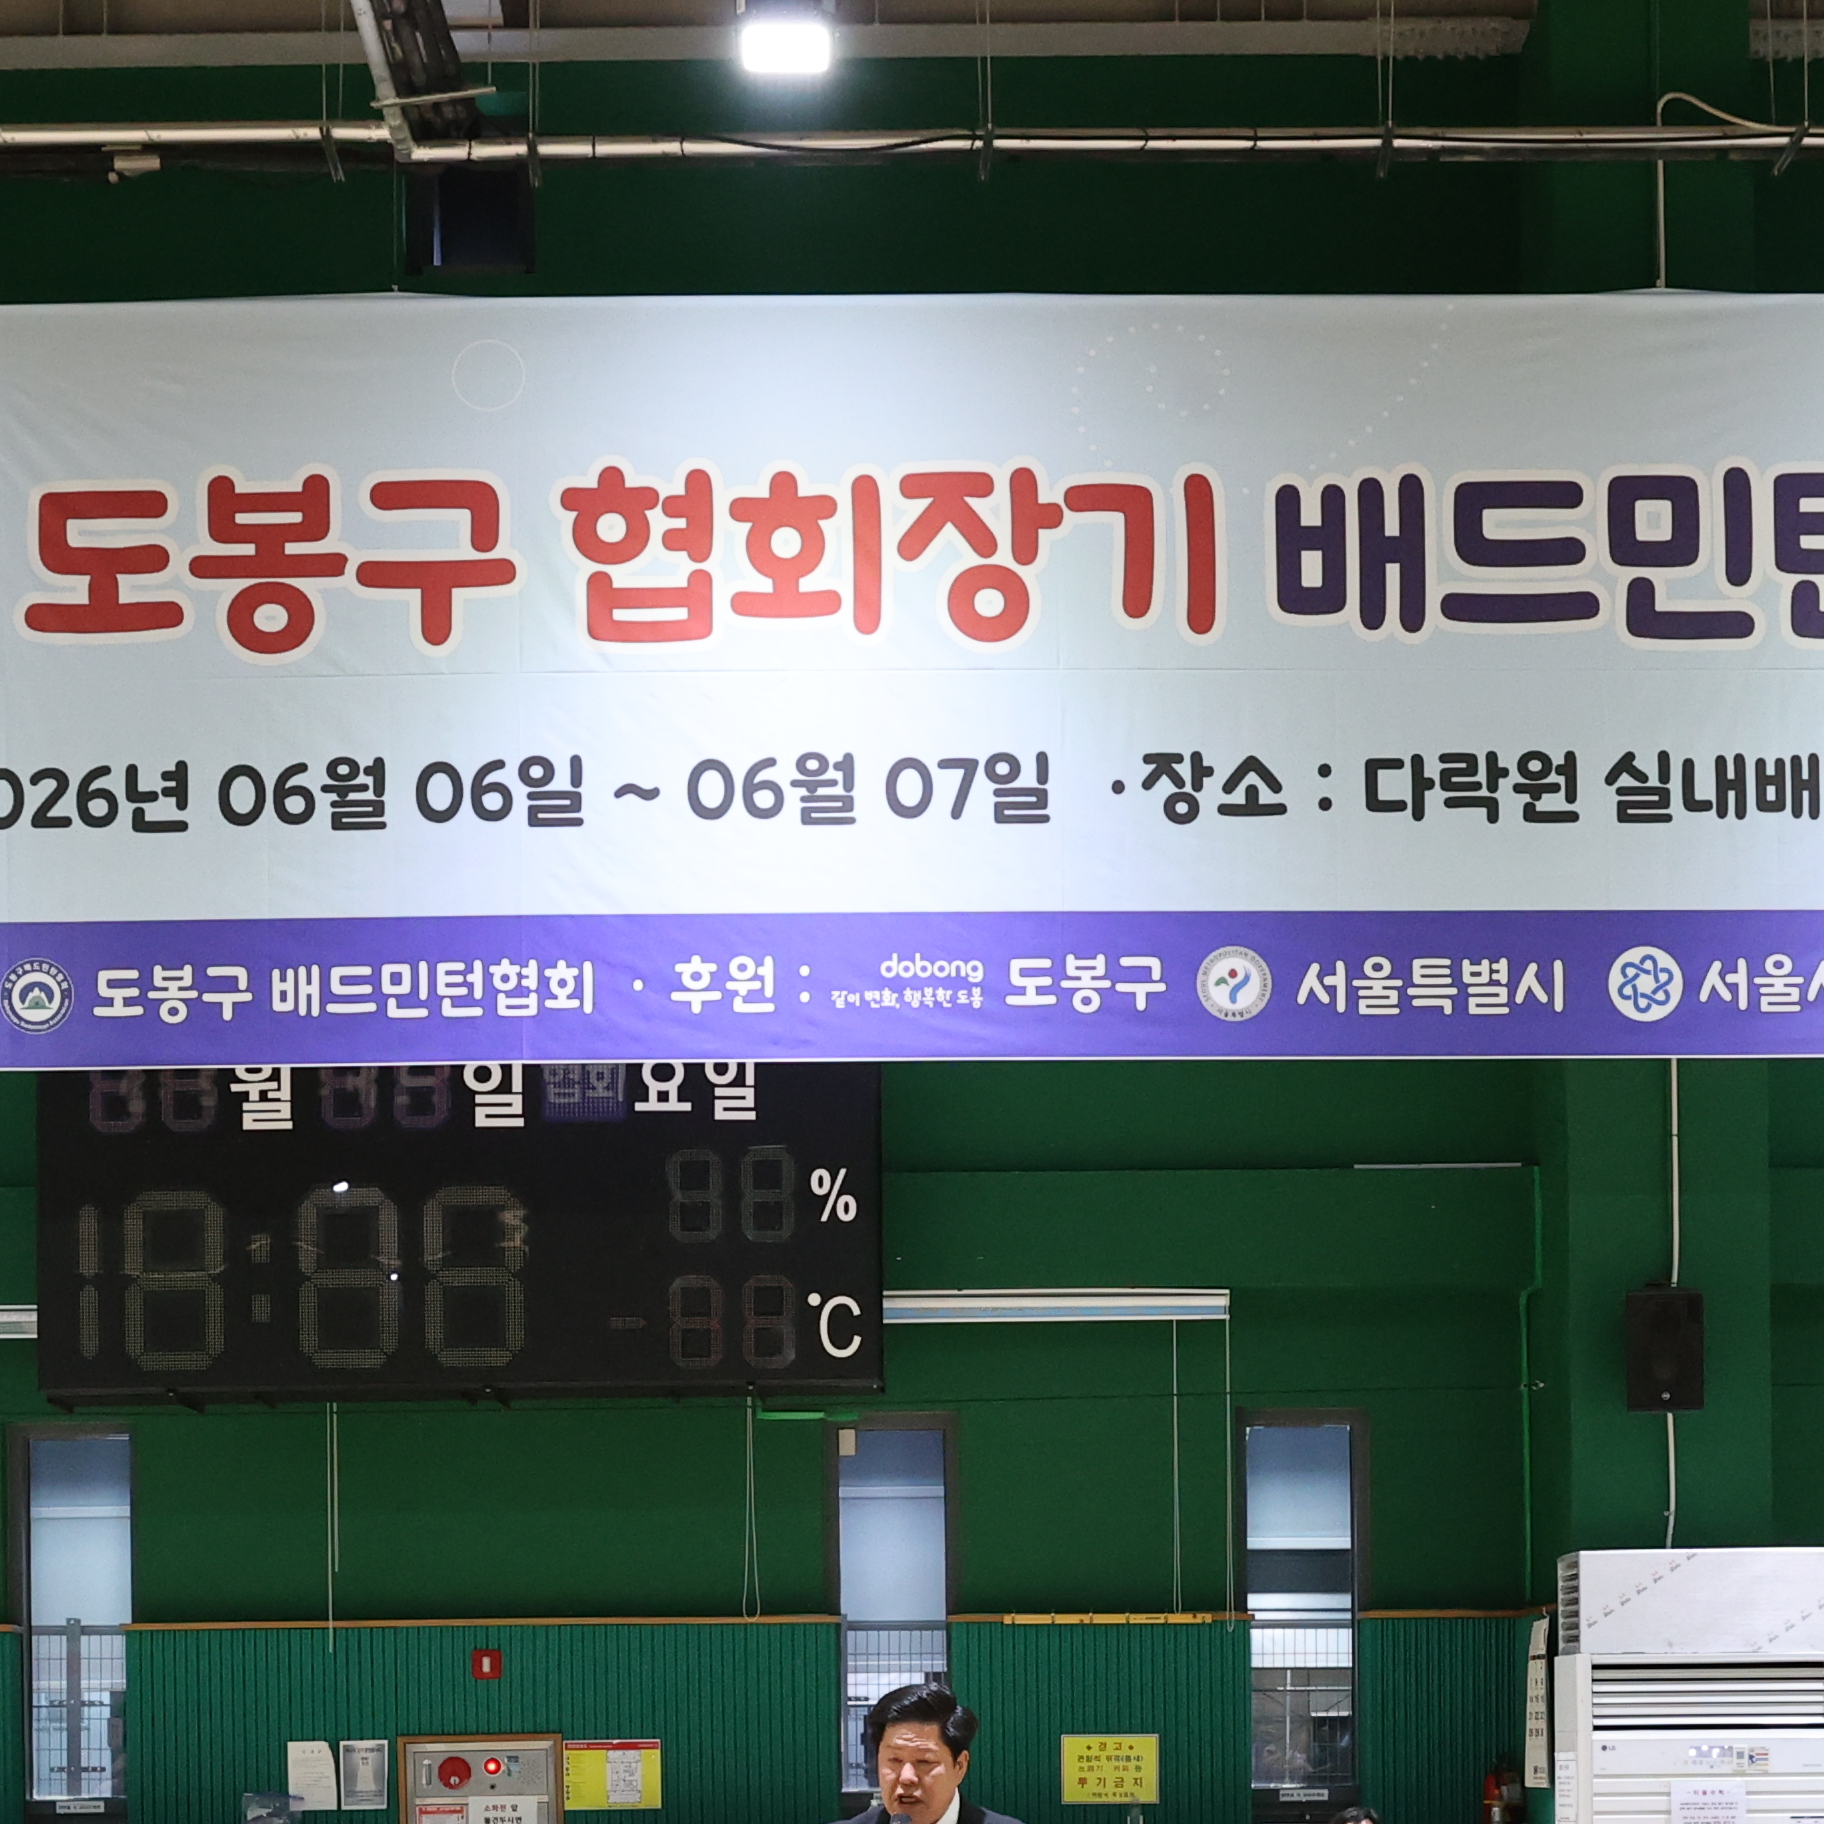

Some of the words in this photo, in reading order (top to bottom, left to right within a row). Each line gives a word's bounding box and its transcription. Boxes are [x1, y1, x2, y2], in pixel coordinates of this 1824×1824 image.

[25, 474, 516, 654] 도봉구
[561, 466, 1217, 643] 협회장기
[218, 757, 387, 831] 06월
[415, 754, 584, 828] 06일
[687, 753, 857, 826] 06월
[886, 751, 1050, 824] 07일
[1364, 750, 1580, 825] 다락원
[93, 965, 253, 1024] 도봉구
[272, 958, 593, 1017] 배드민턴협회
[670, 954, 776, 1015] 후원
[879, 952, 985, 983] dobong
[902, 986, 953, 1009] 행복한
[956, 986, 984, 1009] 도봉
[1005, 953, 1167, 1014] 도봉구
[1297, 957, 1563, 1015] 서울특별시
[229, 1066, 293, 1130] 월
[462, 1063, 525, 1128] 일
[634, 1062, 757, 1121] 요일
